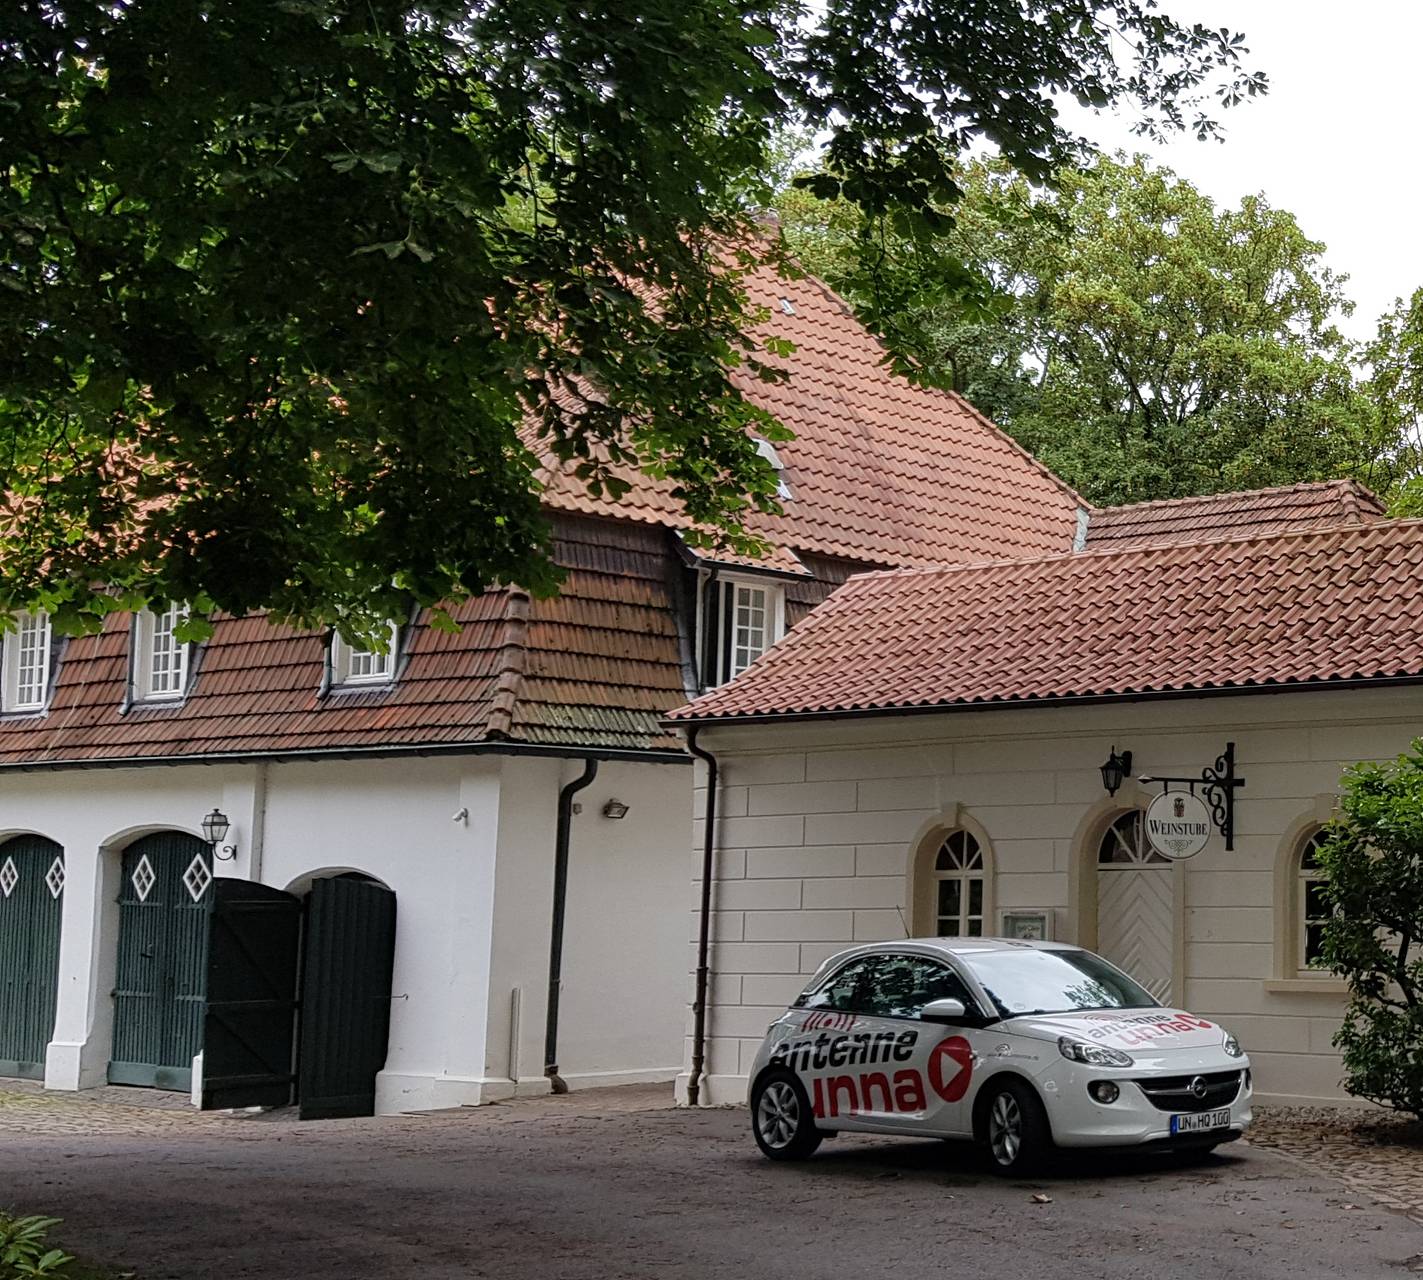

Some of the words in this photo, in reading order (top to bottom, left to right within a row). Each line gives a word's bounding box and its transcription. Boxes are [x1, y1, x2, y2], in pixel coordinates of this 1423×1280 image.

[1149, 819, 1208, 836] WEINSTUBE
[1088, 1014, 1172, 1039] antenne
[769, 1030, 919, 1071] antenne
[1178, 1115, 1192, 1130] UN
